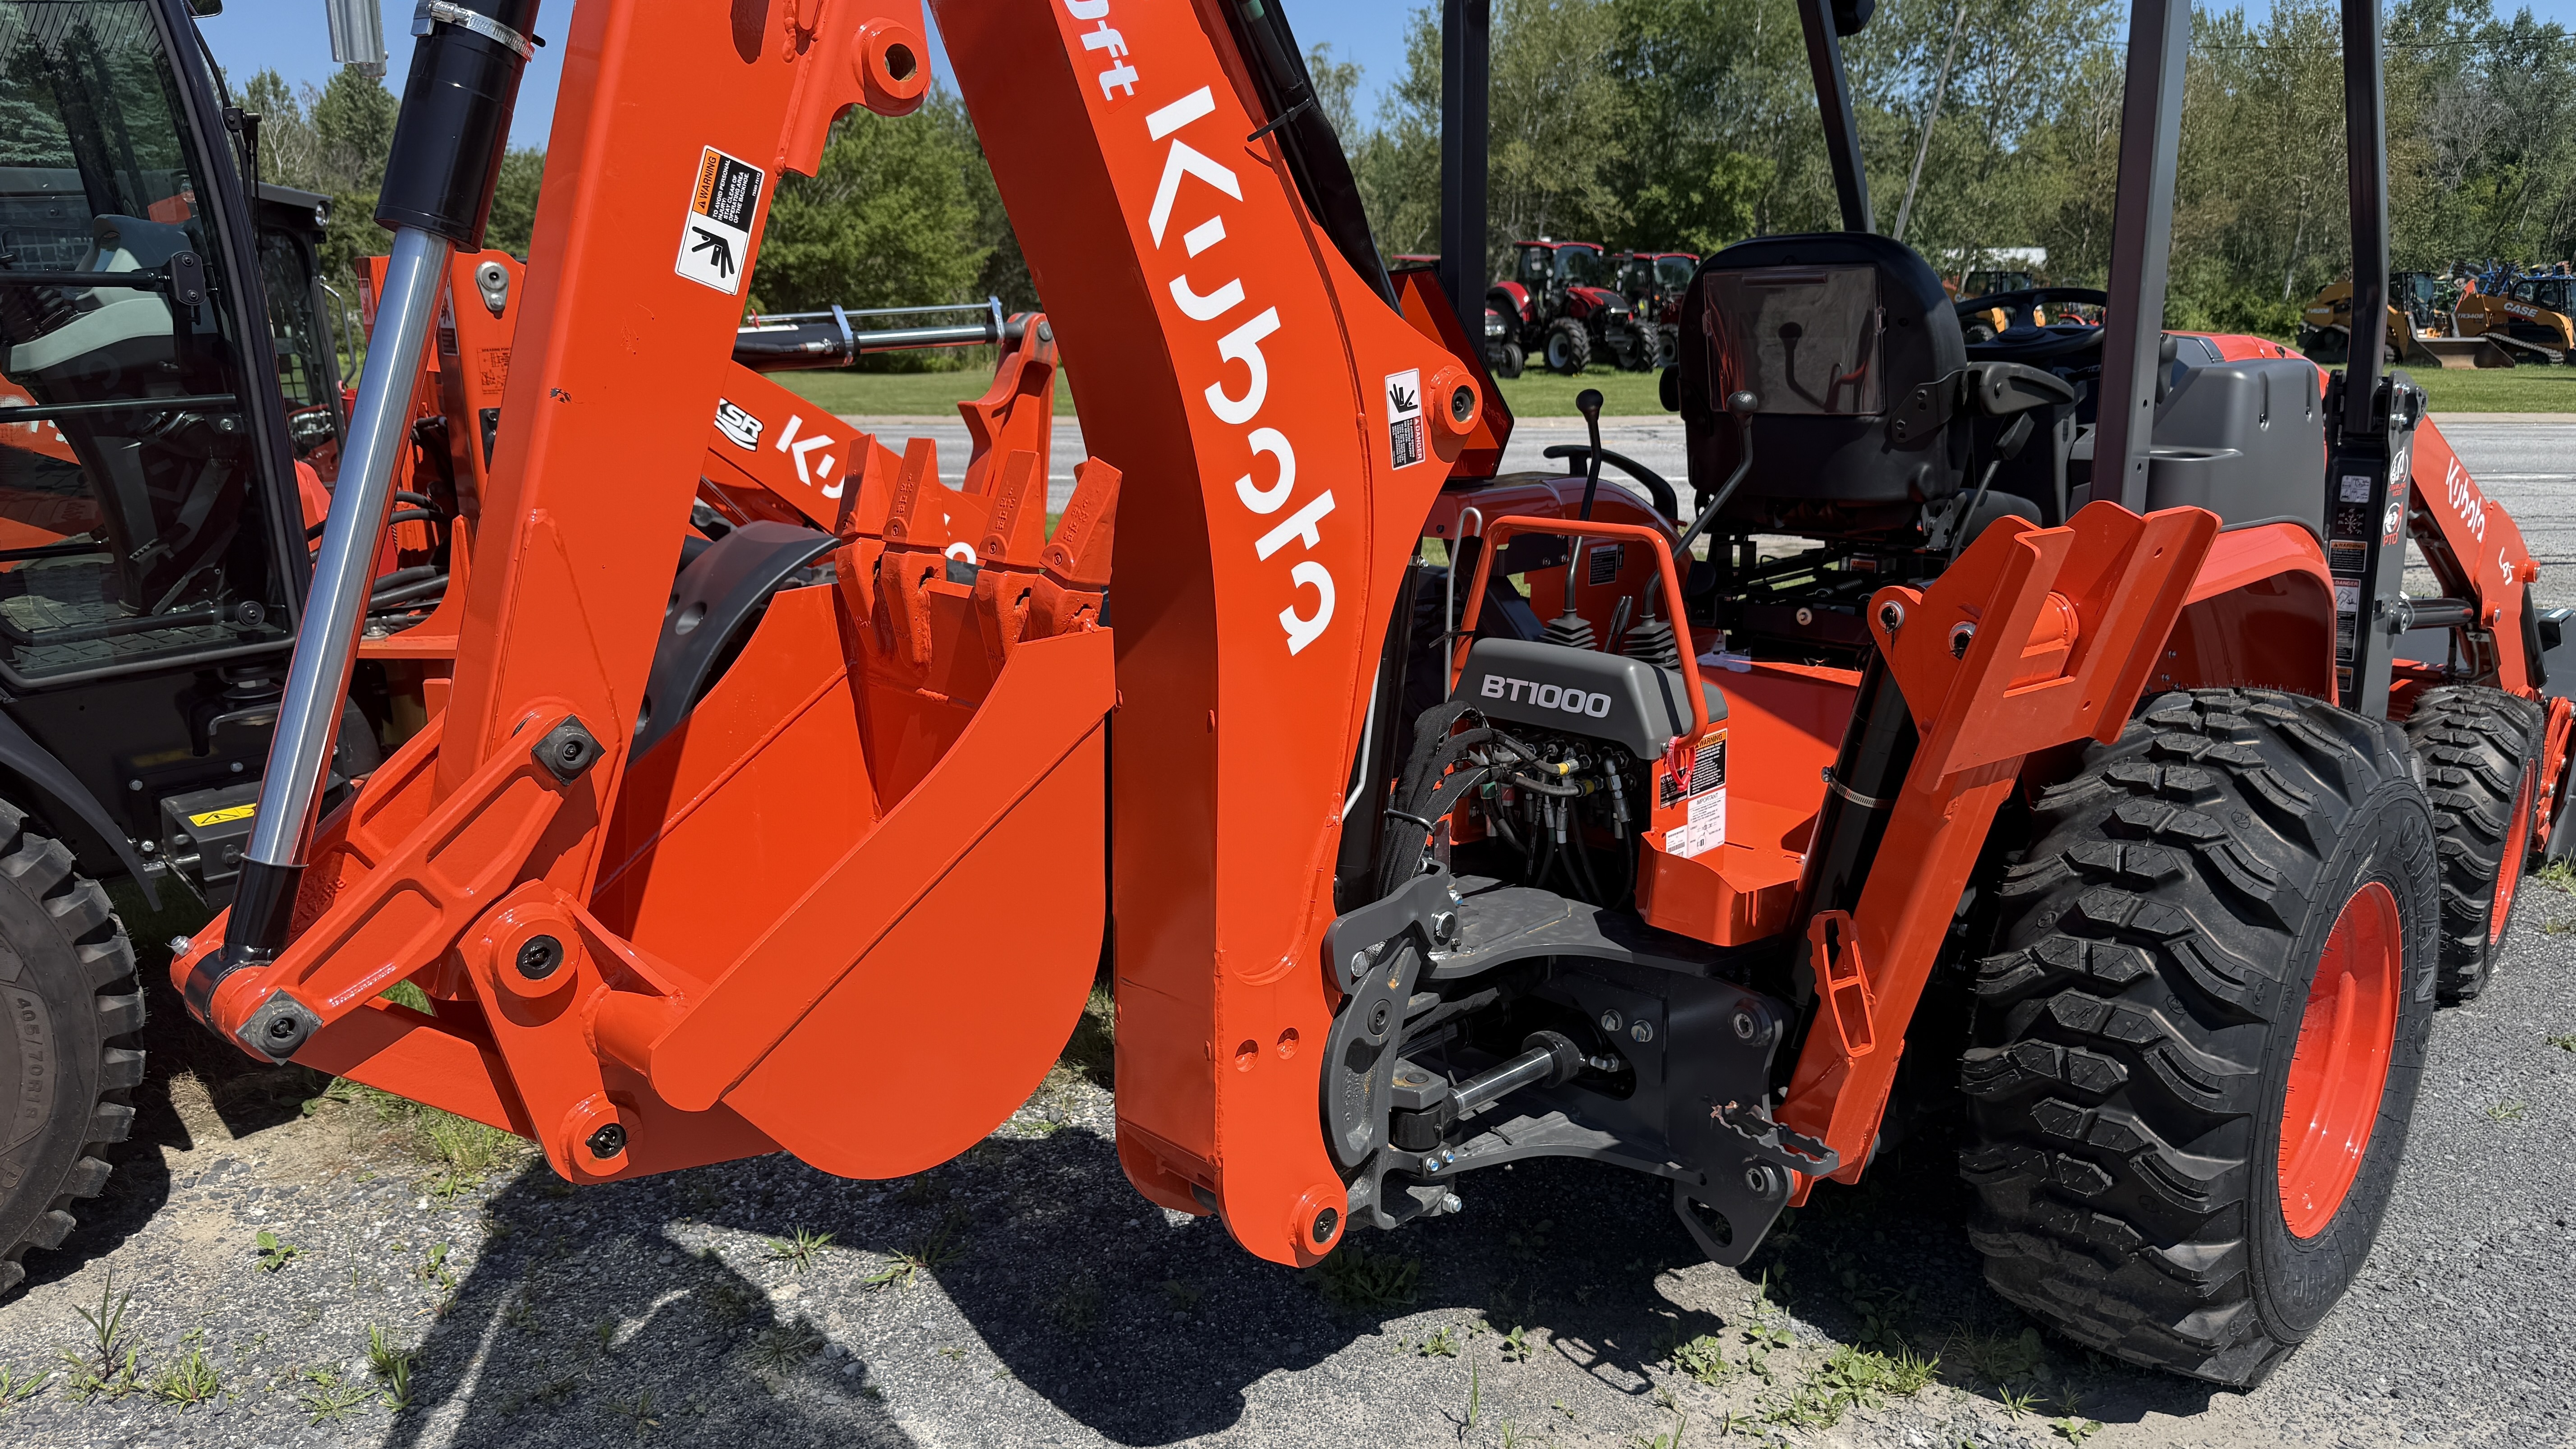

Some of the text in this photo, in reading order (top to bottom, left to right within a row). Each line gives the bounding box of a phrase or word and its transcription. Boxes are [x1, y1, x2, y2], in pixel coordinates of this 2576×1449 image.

[700, 156, 716, 199] WARNING
[713, 160, 731, 218] TO AVOID PERSONAL
[727, 184, 735, 203] CLEAR
[728, 189, 740, 221] OPERATING
[2504, 302, 2538, 317] CASE
[1145, 85, 1335, 656] Kubota
[2446, 456, 2485, 543] Kubota
[2383, 532, 2398, 547] PTO
[1481, 674, 1611, 718] BT1000
[1700, 734, 1722, 747] WARNING
[1697, 792, 1718, 805] IMPORTANT
[16, 997, 44, 1119] 405/70R18
